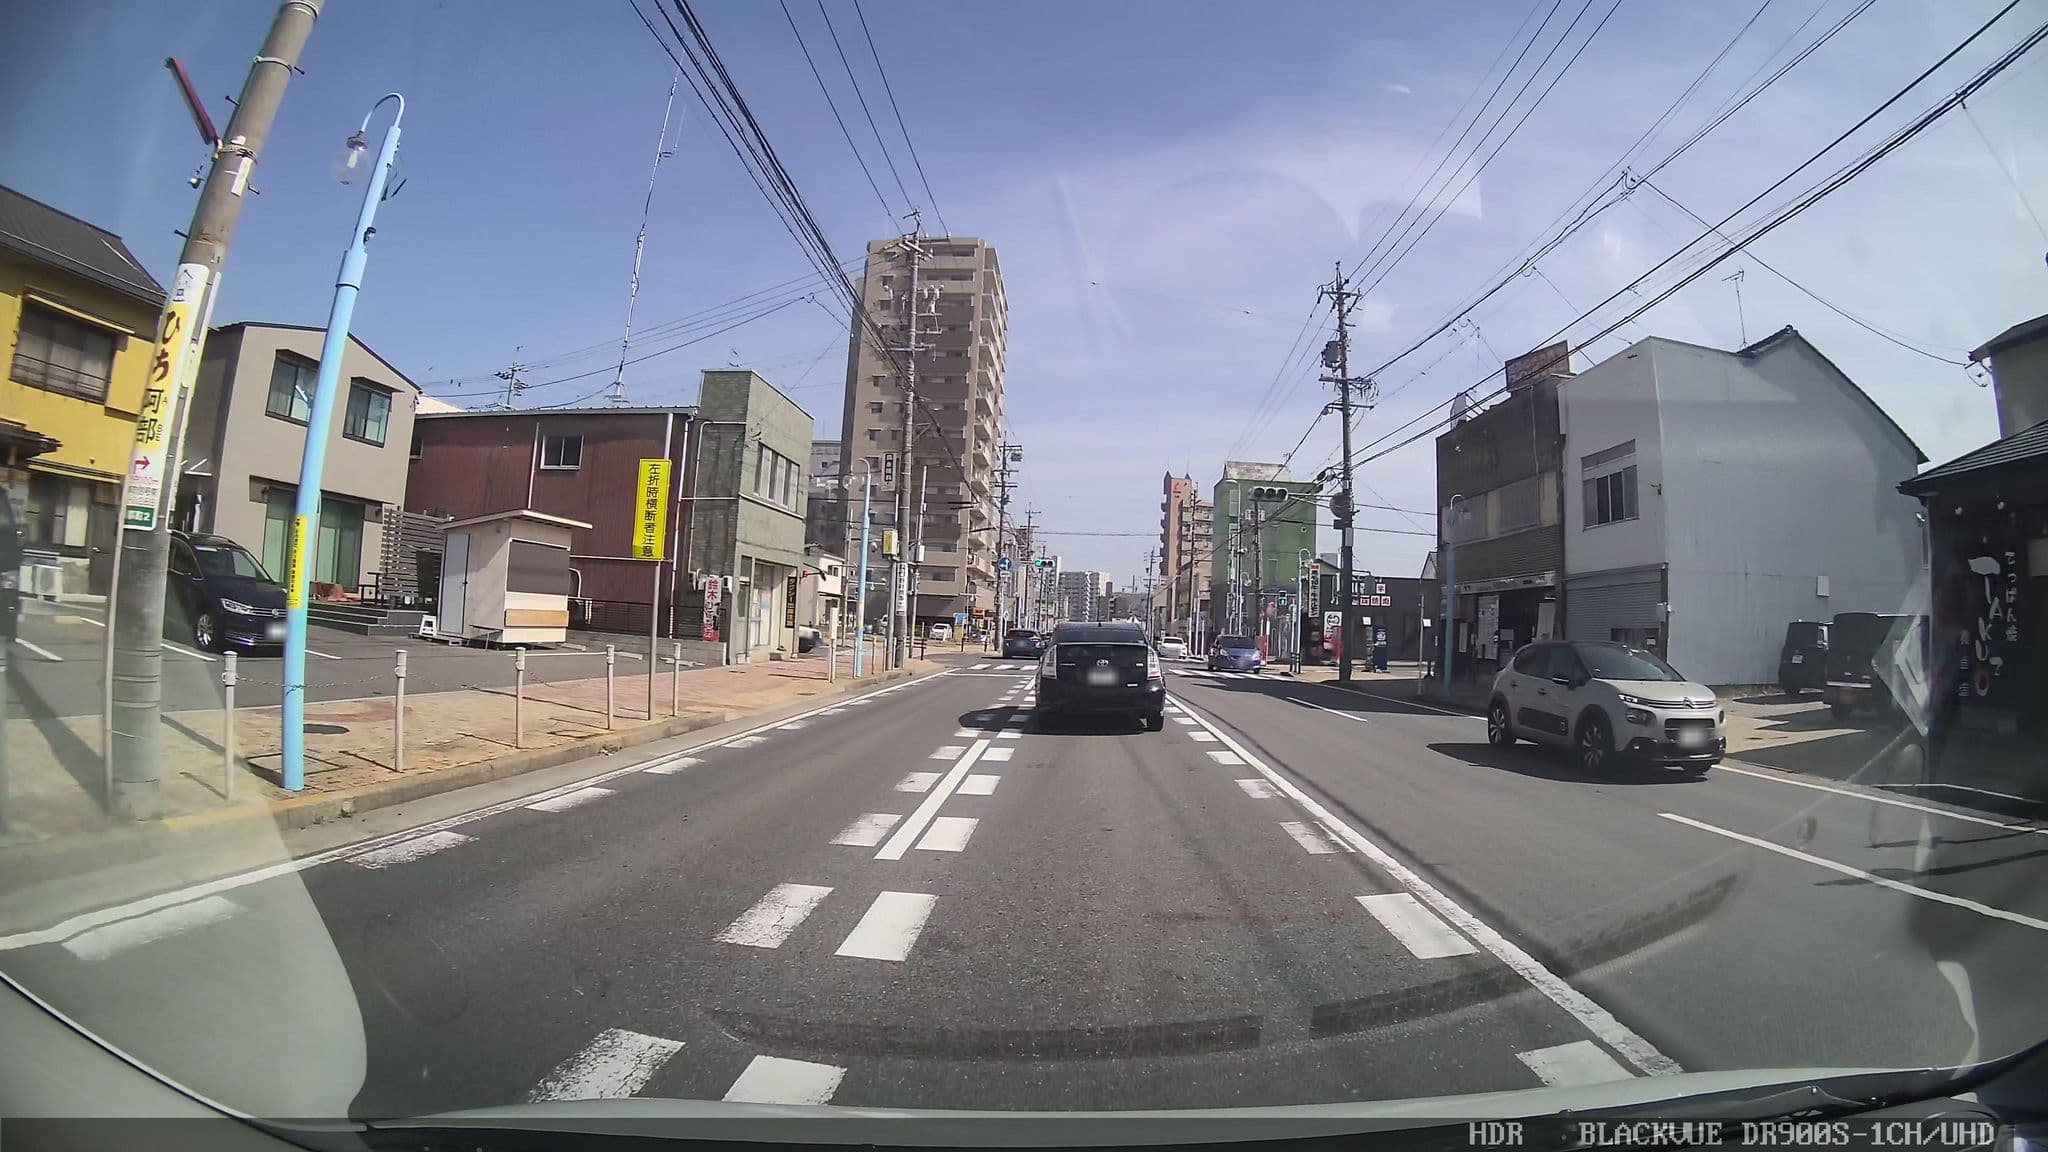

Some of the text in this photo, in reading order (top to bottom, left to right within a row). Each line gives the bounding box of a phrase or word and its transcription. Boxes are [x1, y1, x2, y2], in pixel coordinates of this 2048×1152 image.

[641, 464, 661, 558] 左折時横断者注意
